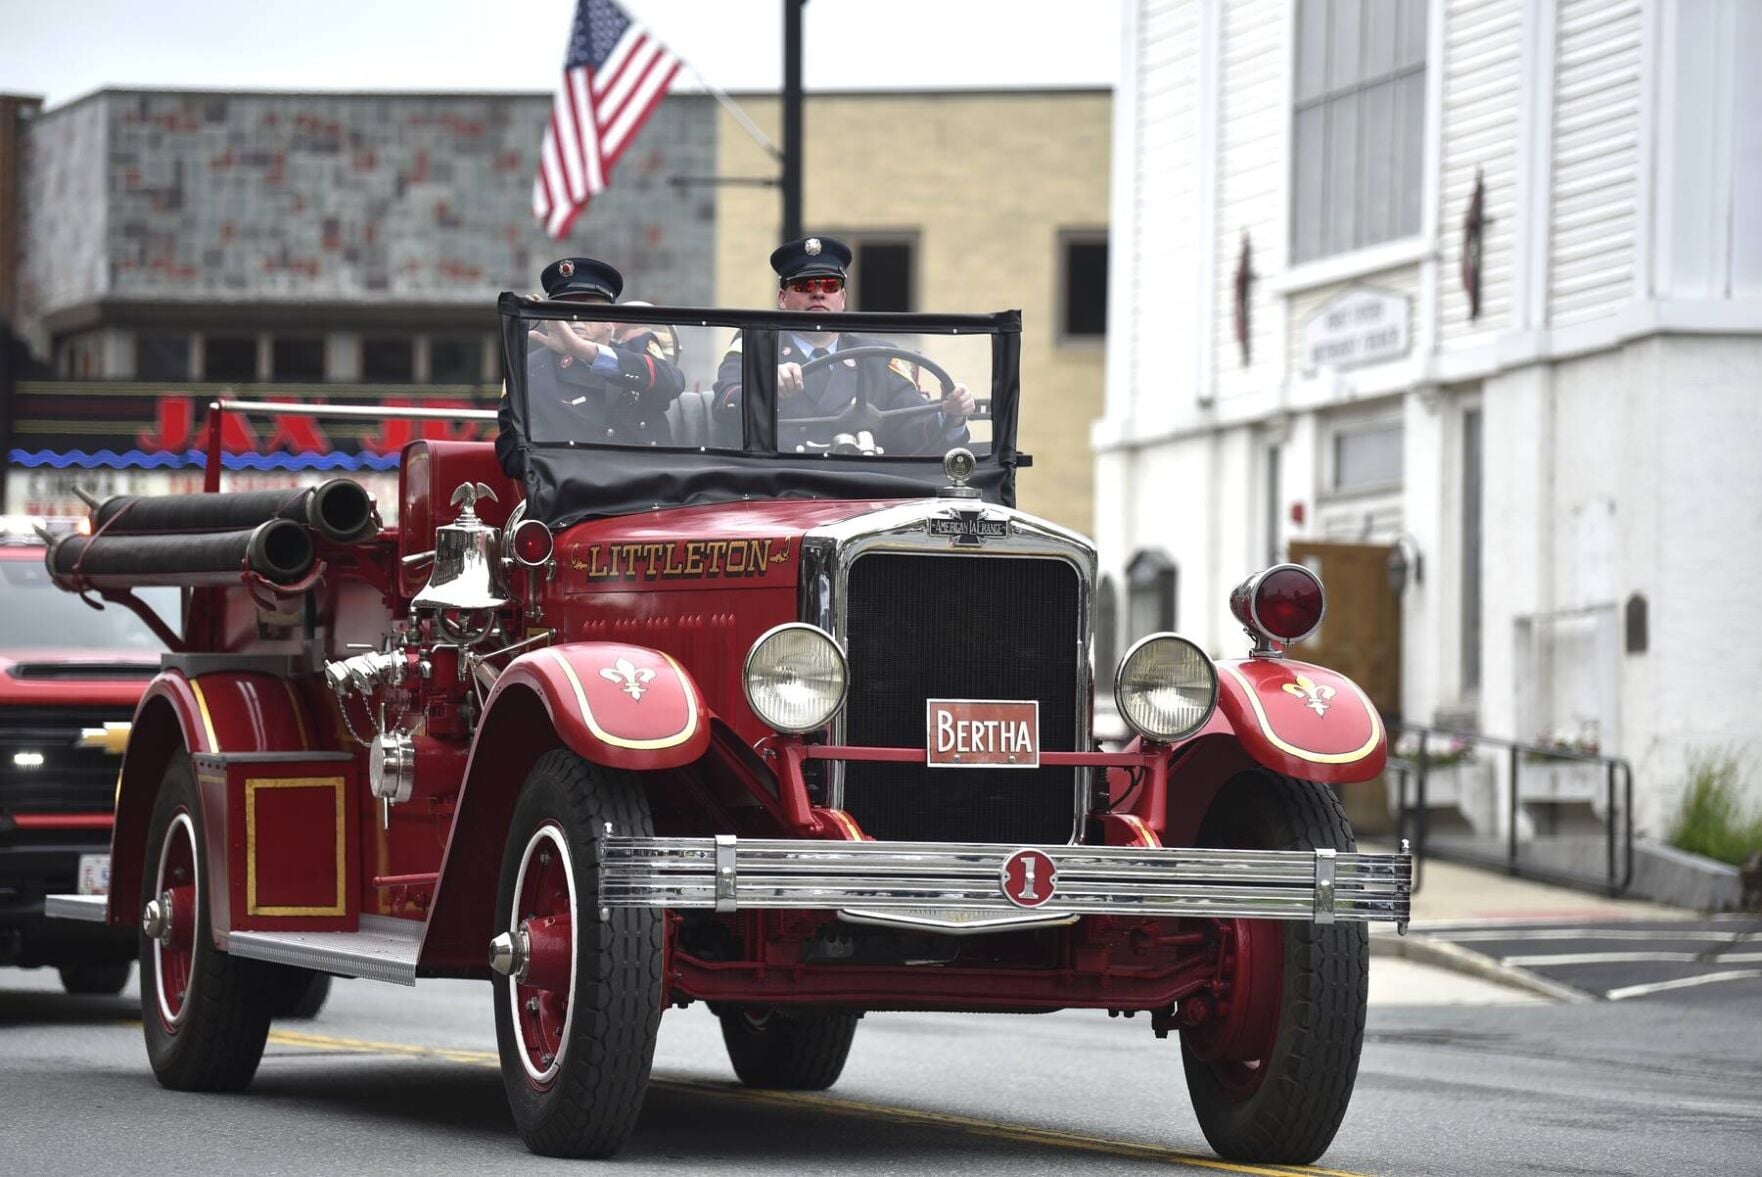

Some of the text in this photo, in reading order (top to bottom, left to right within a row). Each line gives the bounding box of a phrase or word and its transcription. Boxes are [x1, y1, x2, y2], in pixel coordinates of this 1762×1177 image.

[136, 391, 332, 453] JAX
[936, 520, 968, 535] AMERICAN
[587, 539, 772, 580] LITTLETON
[937, 709, 1033, 753] BERTHA
[1017, 856, 1040, 900] 1
